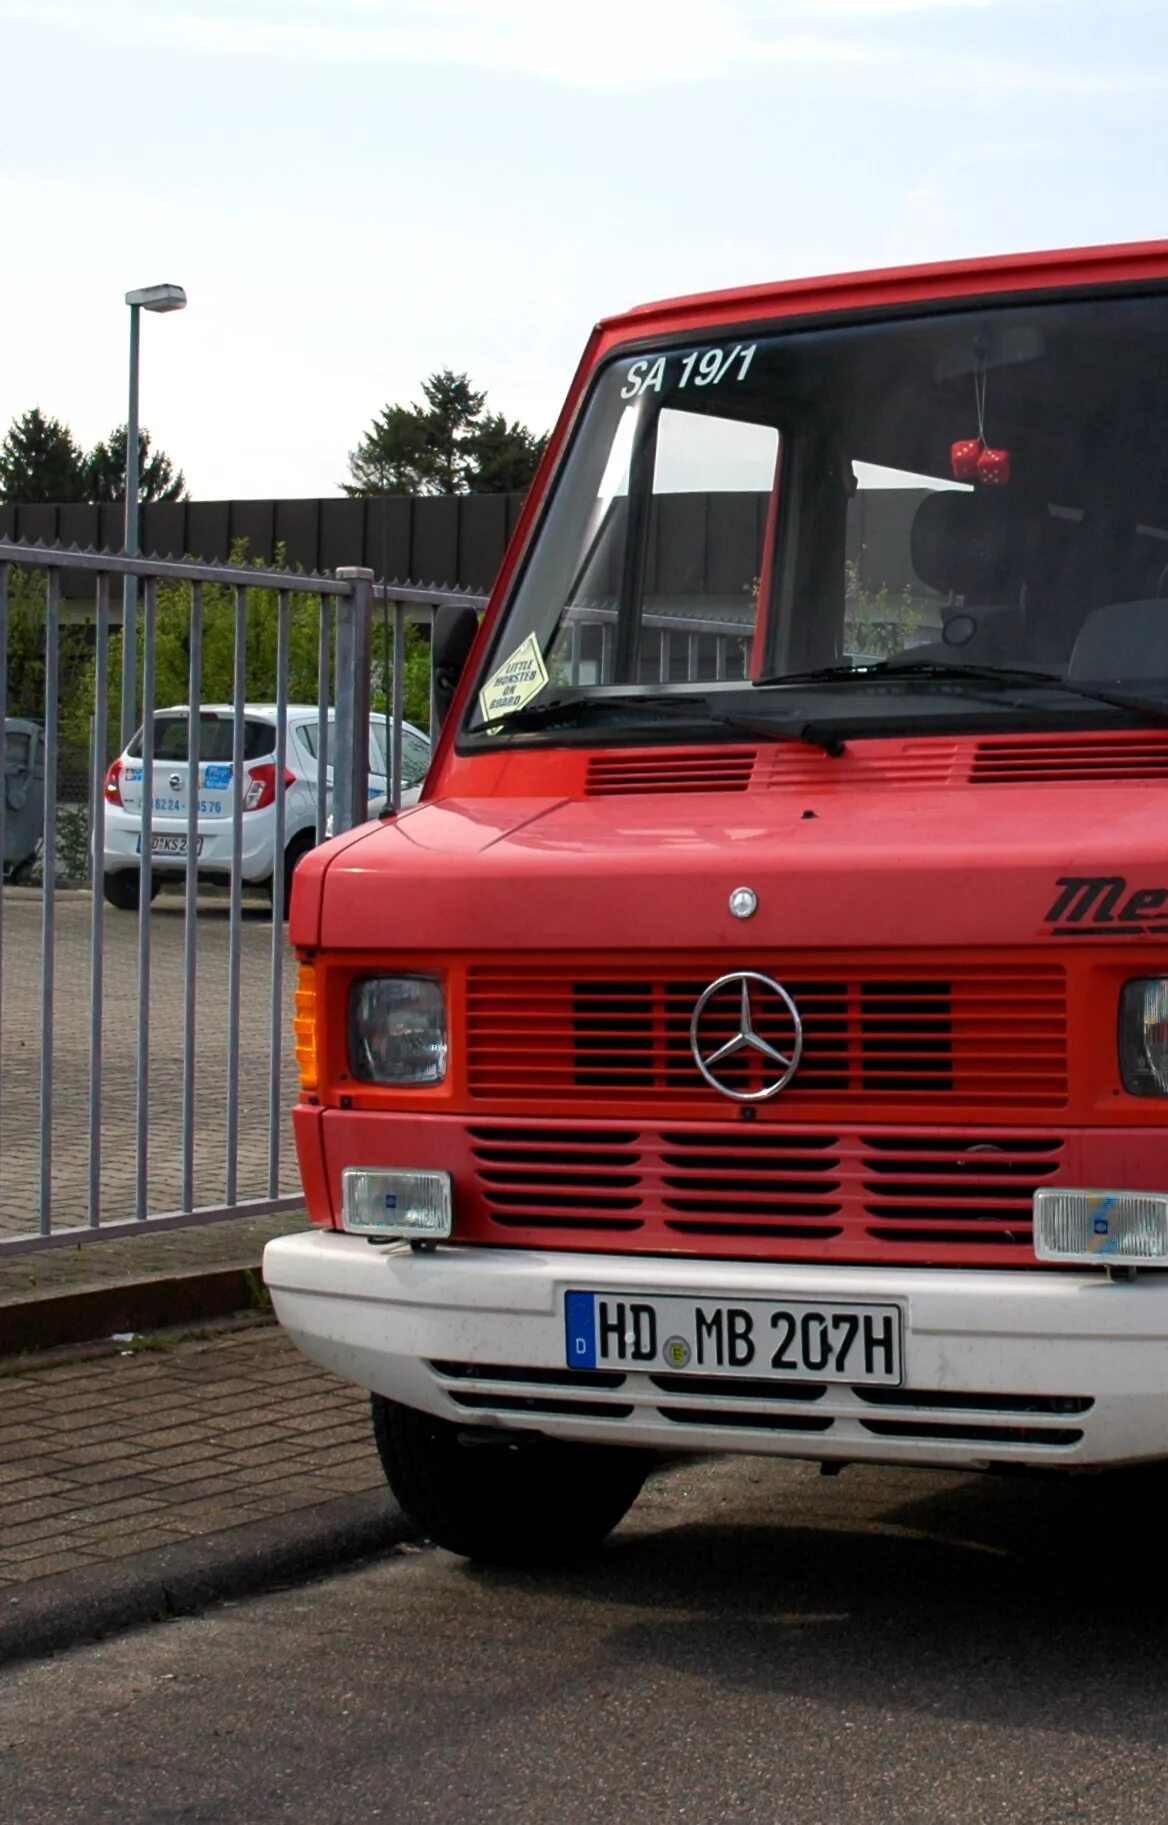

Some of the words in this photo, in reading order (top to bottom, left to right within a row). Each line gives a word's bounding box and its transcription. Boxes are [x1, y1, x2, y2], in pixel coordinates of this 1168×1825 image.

[620, 357, 667, 399] SA
[678, 344, 758, 388] 19/1
[505, 660, 533, 674] LITTLE
[599, 1301, 657, 1361] HD
[695, 1306, 756, 1367] MB
[770, 1310, 894, 1375] 207H
